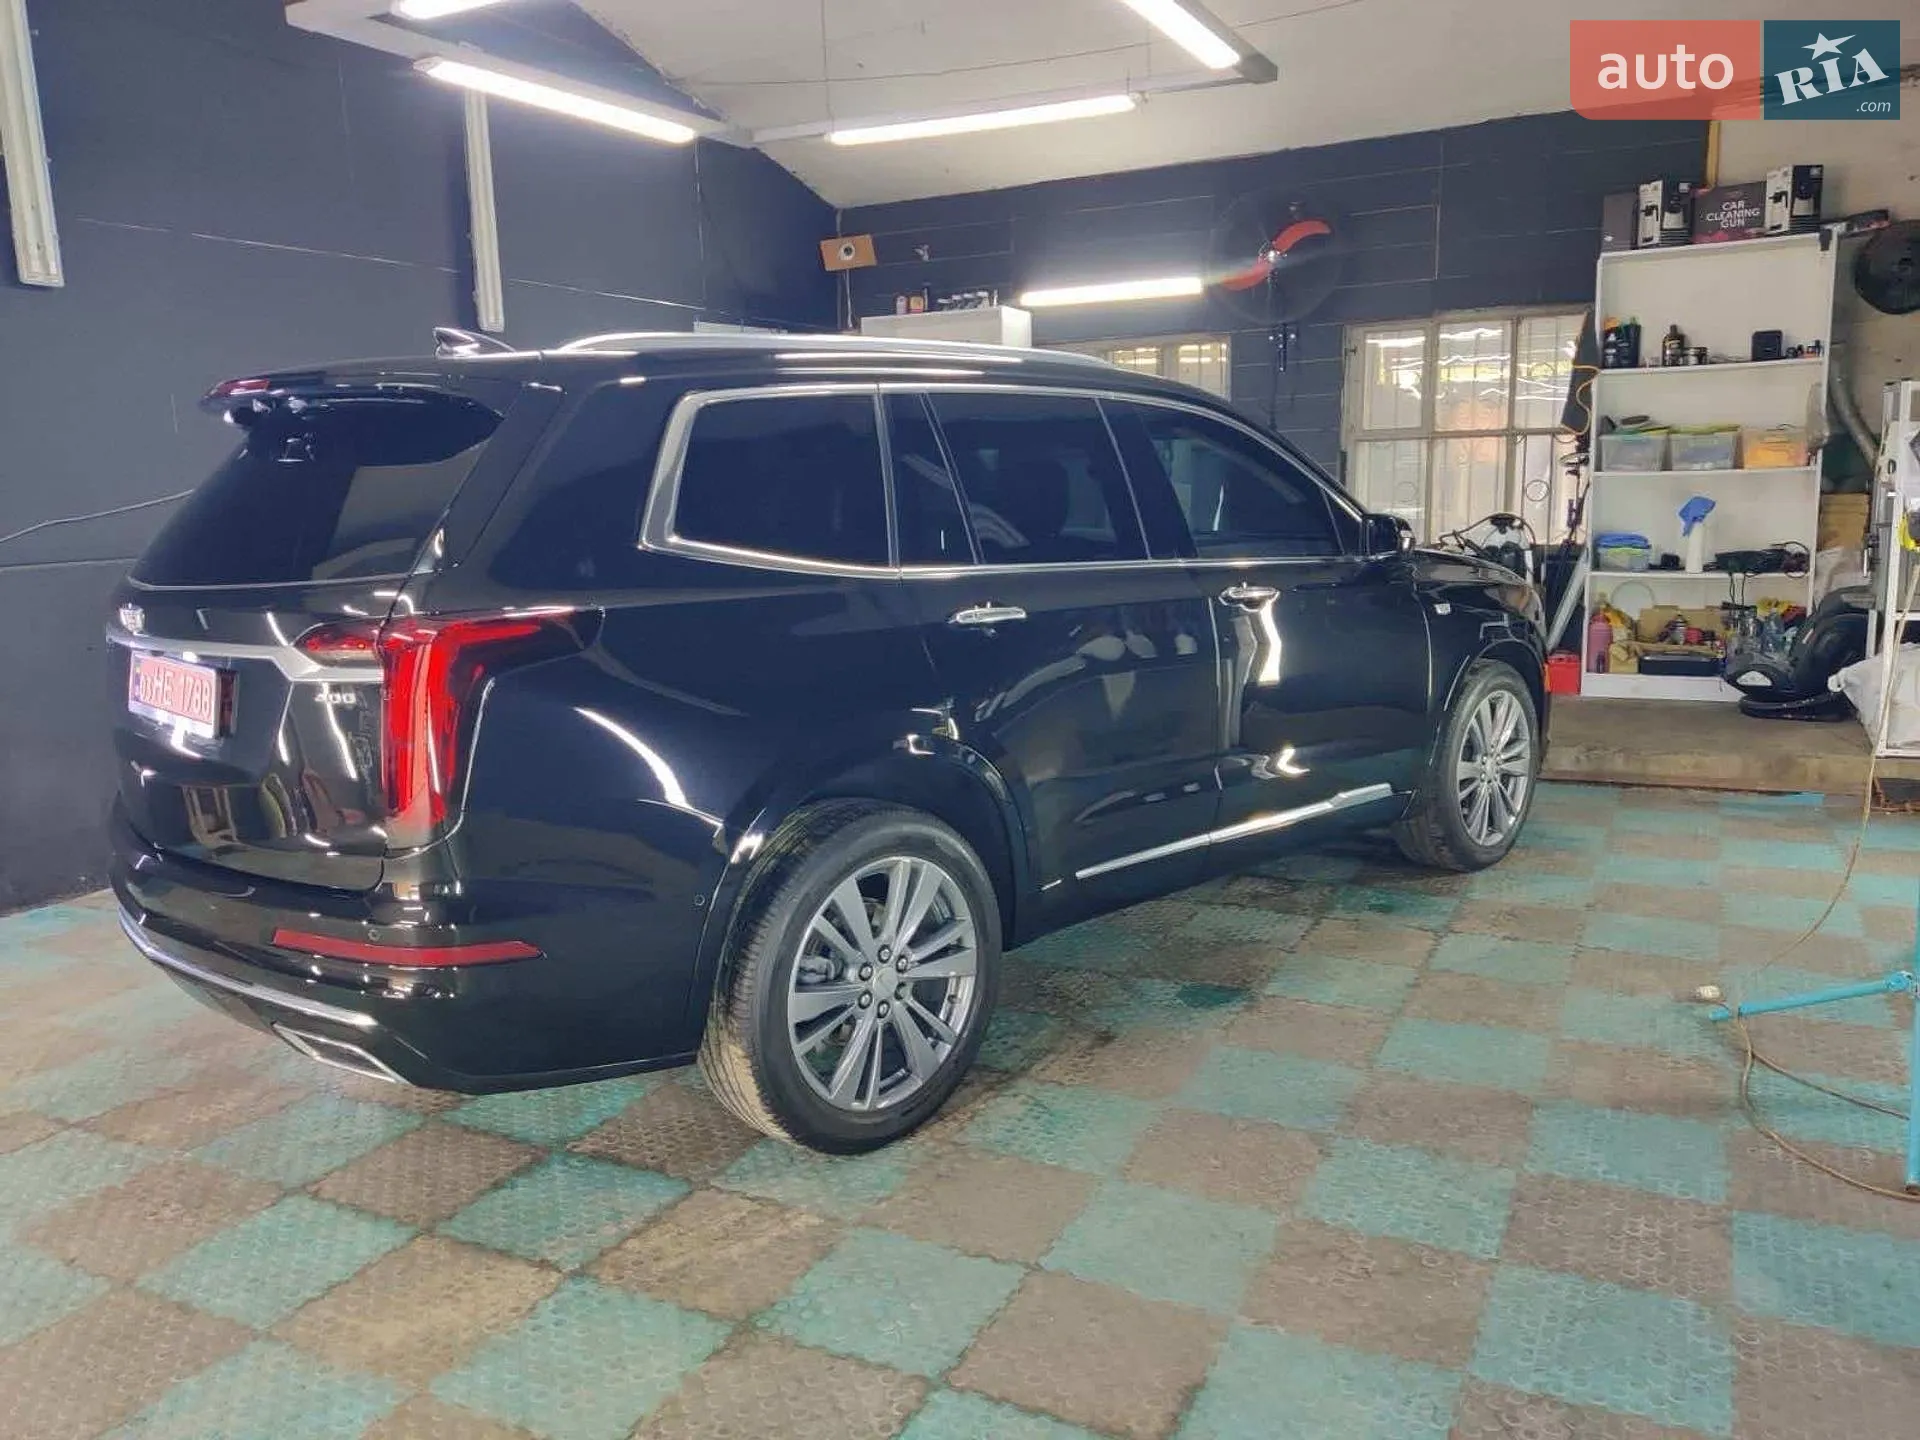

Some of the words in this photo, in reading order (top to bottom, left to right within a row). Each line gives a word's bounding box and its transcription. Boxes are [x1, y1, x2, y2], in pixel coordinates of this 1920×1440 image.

[1722, 200, 1746, 211] CAR
[1705, 207, 1761, 222] CLEANING
[1720, 218, 1746, 228] GUN
